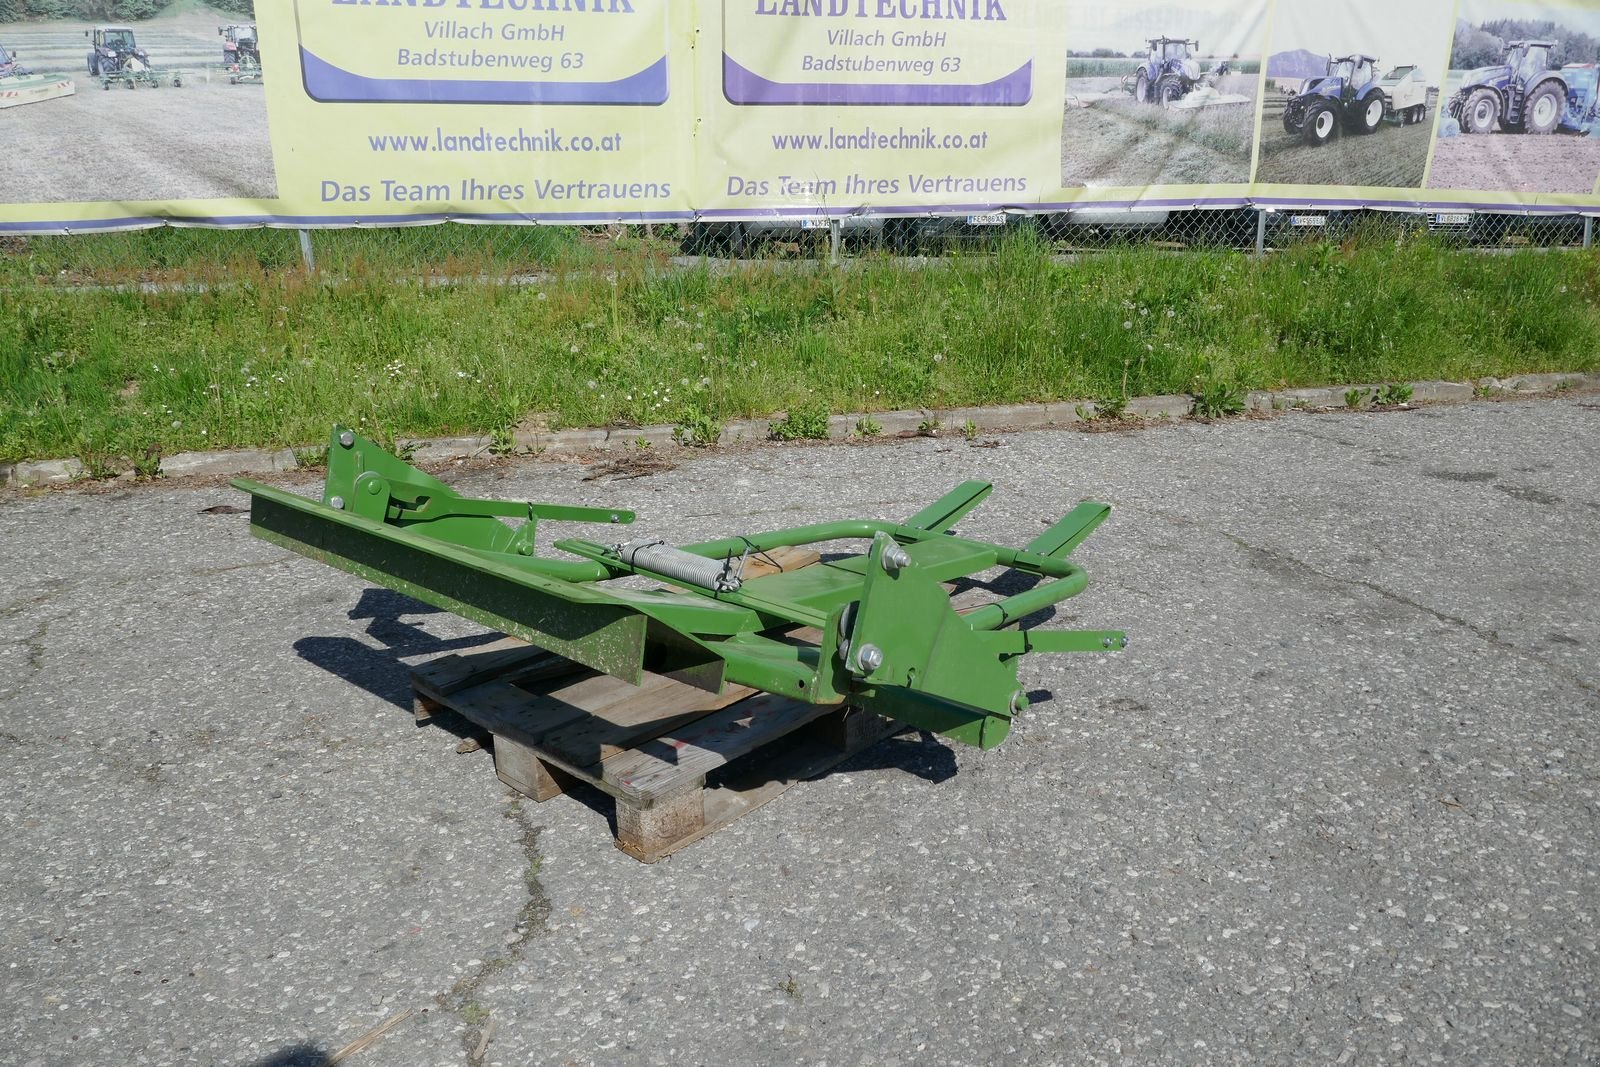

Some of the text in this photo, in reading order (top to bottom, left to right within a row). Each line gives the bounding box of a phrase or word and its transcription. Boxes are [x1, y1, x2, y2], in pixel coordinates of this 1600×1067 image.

[755, 0, 1007, 21] LANDTECHNIK
[425, 21, 565, 41] Villach GmbH
[827, 29, 947, 48] Villach GmbH
[397, 48, 584, 73] Badstubenweg 63
[802, 55, 961, 76] Badstubenweg 63
[368, 127, 622, 152] www.landtechnik.co.at
[772, 127, 988, 150] www.landtechnik.co.at
[321, 178, 671, 202] Das Team Ihres Vertrauens
[727, 174, 1027, 196] Das Team Ihres Vertrauens
